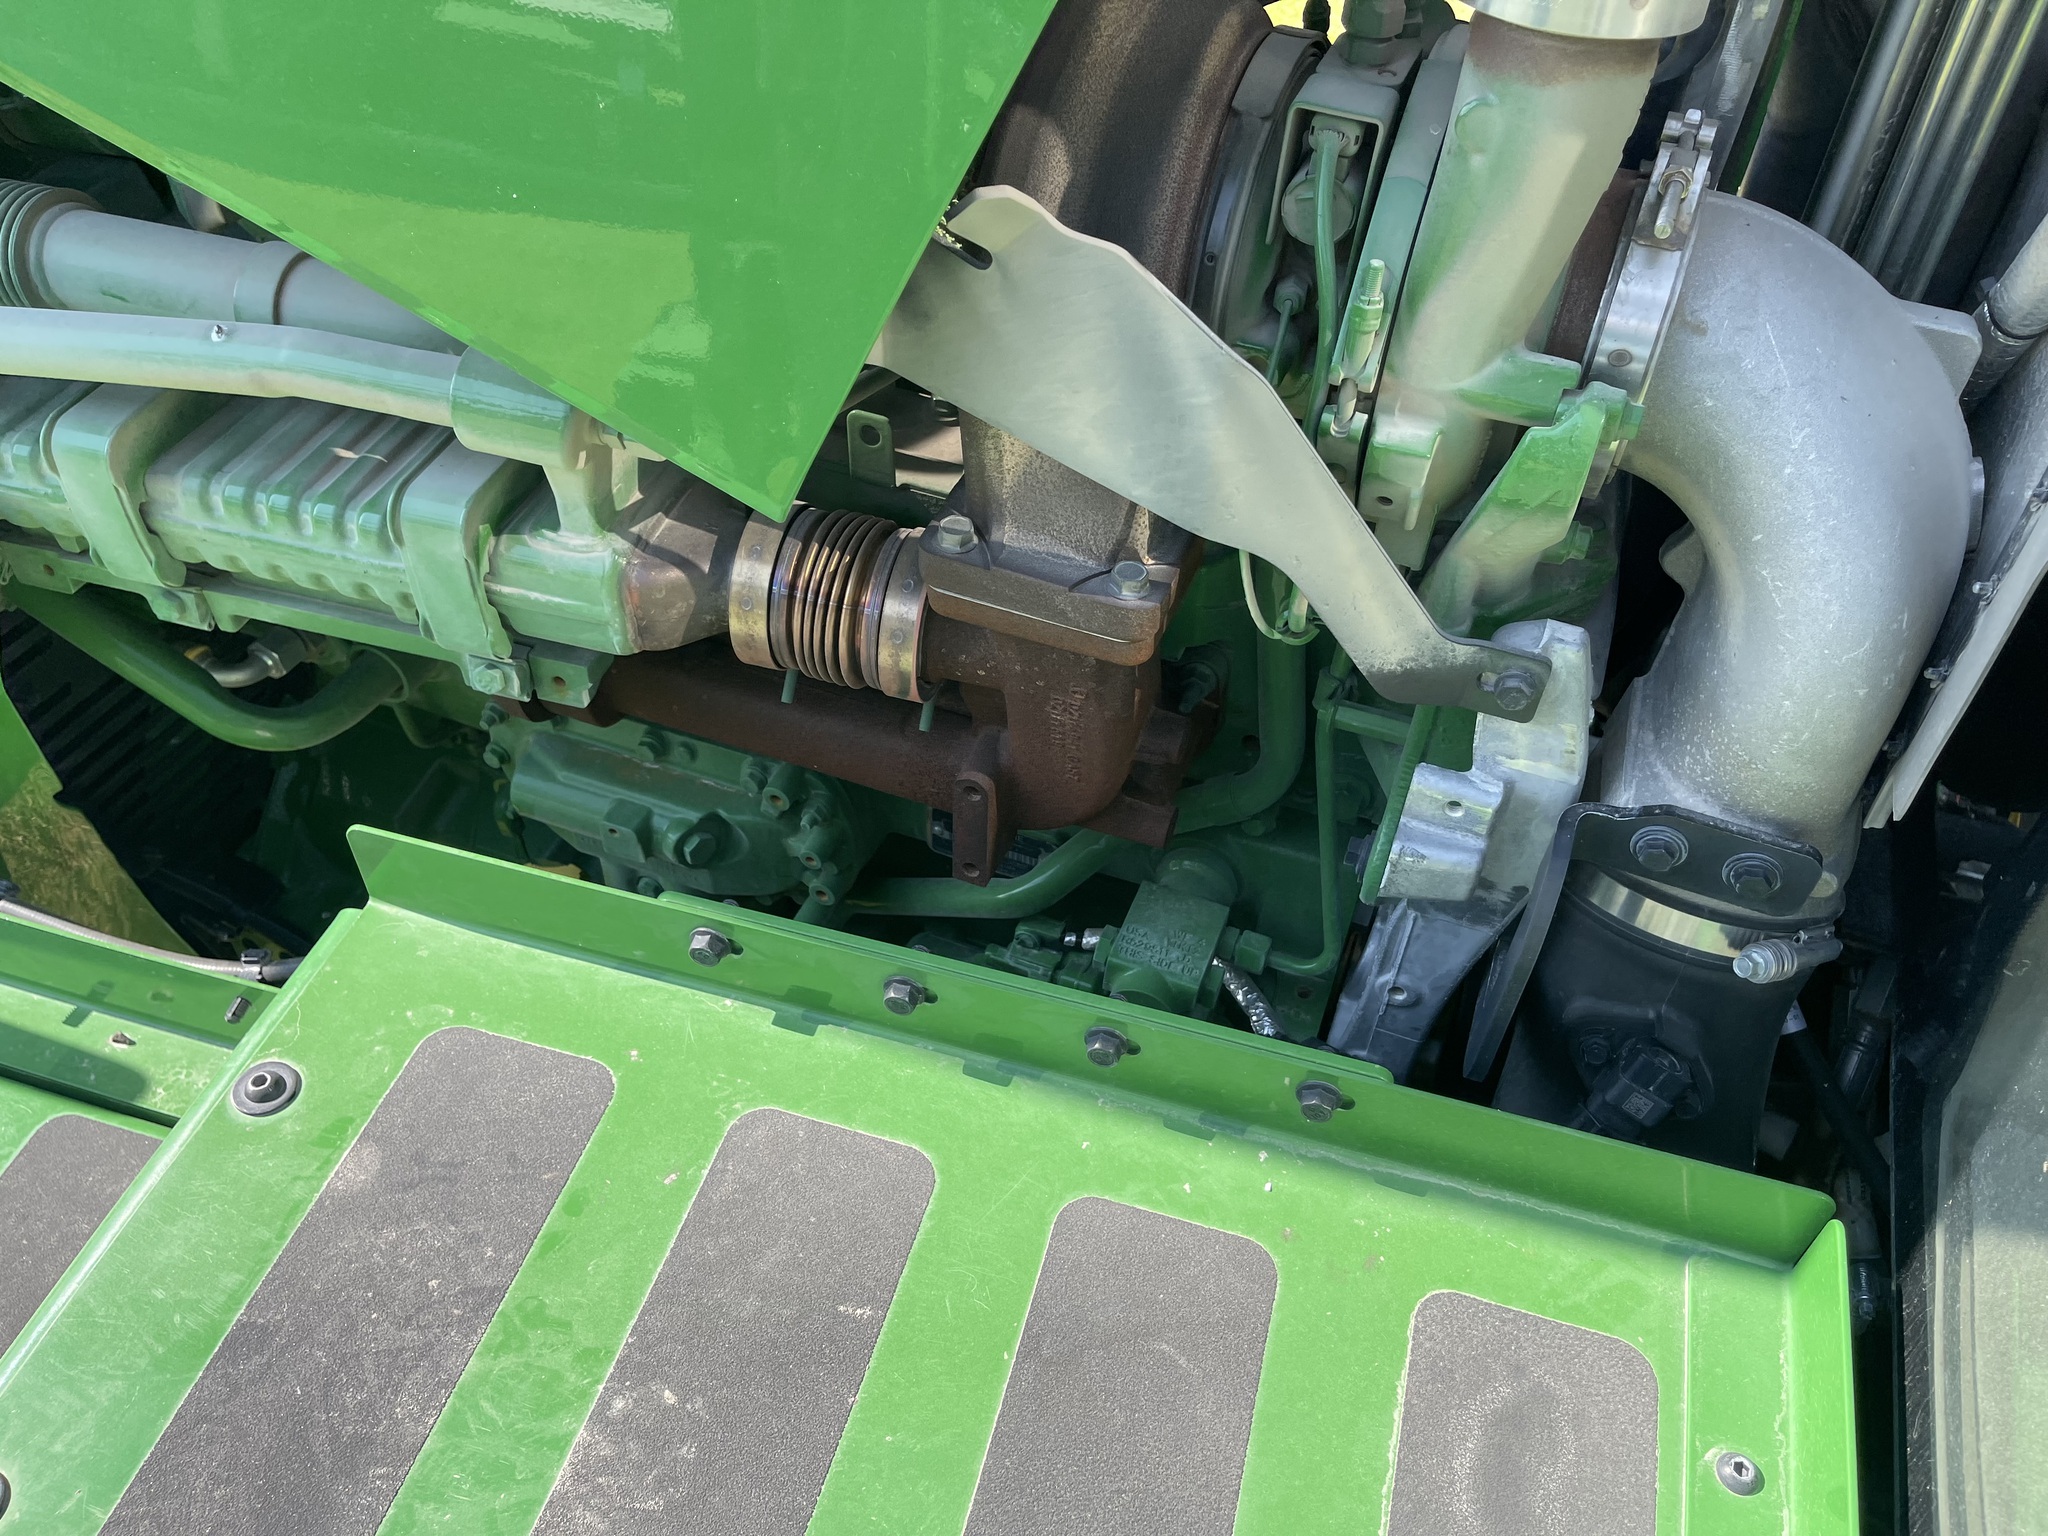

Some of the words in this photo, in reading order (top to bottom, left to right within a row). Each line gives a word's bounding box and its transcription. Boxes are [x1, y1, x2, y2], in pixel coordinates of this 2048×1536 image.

[1125, 925, 1149, 940] USA
[1118, 944, 1144, 959] THIS
[1148, 954, 1174, 970] SIDE
[1181, 963, 1200, 977] UP
